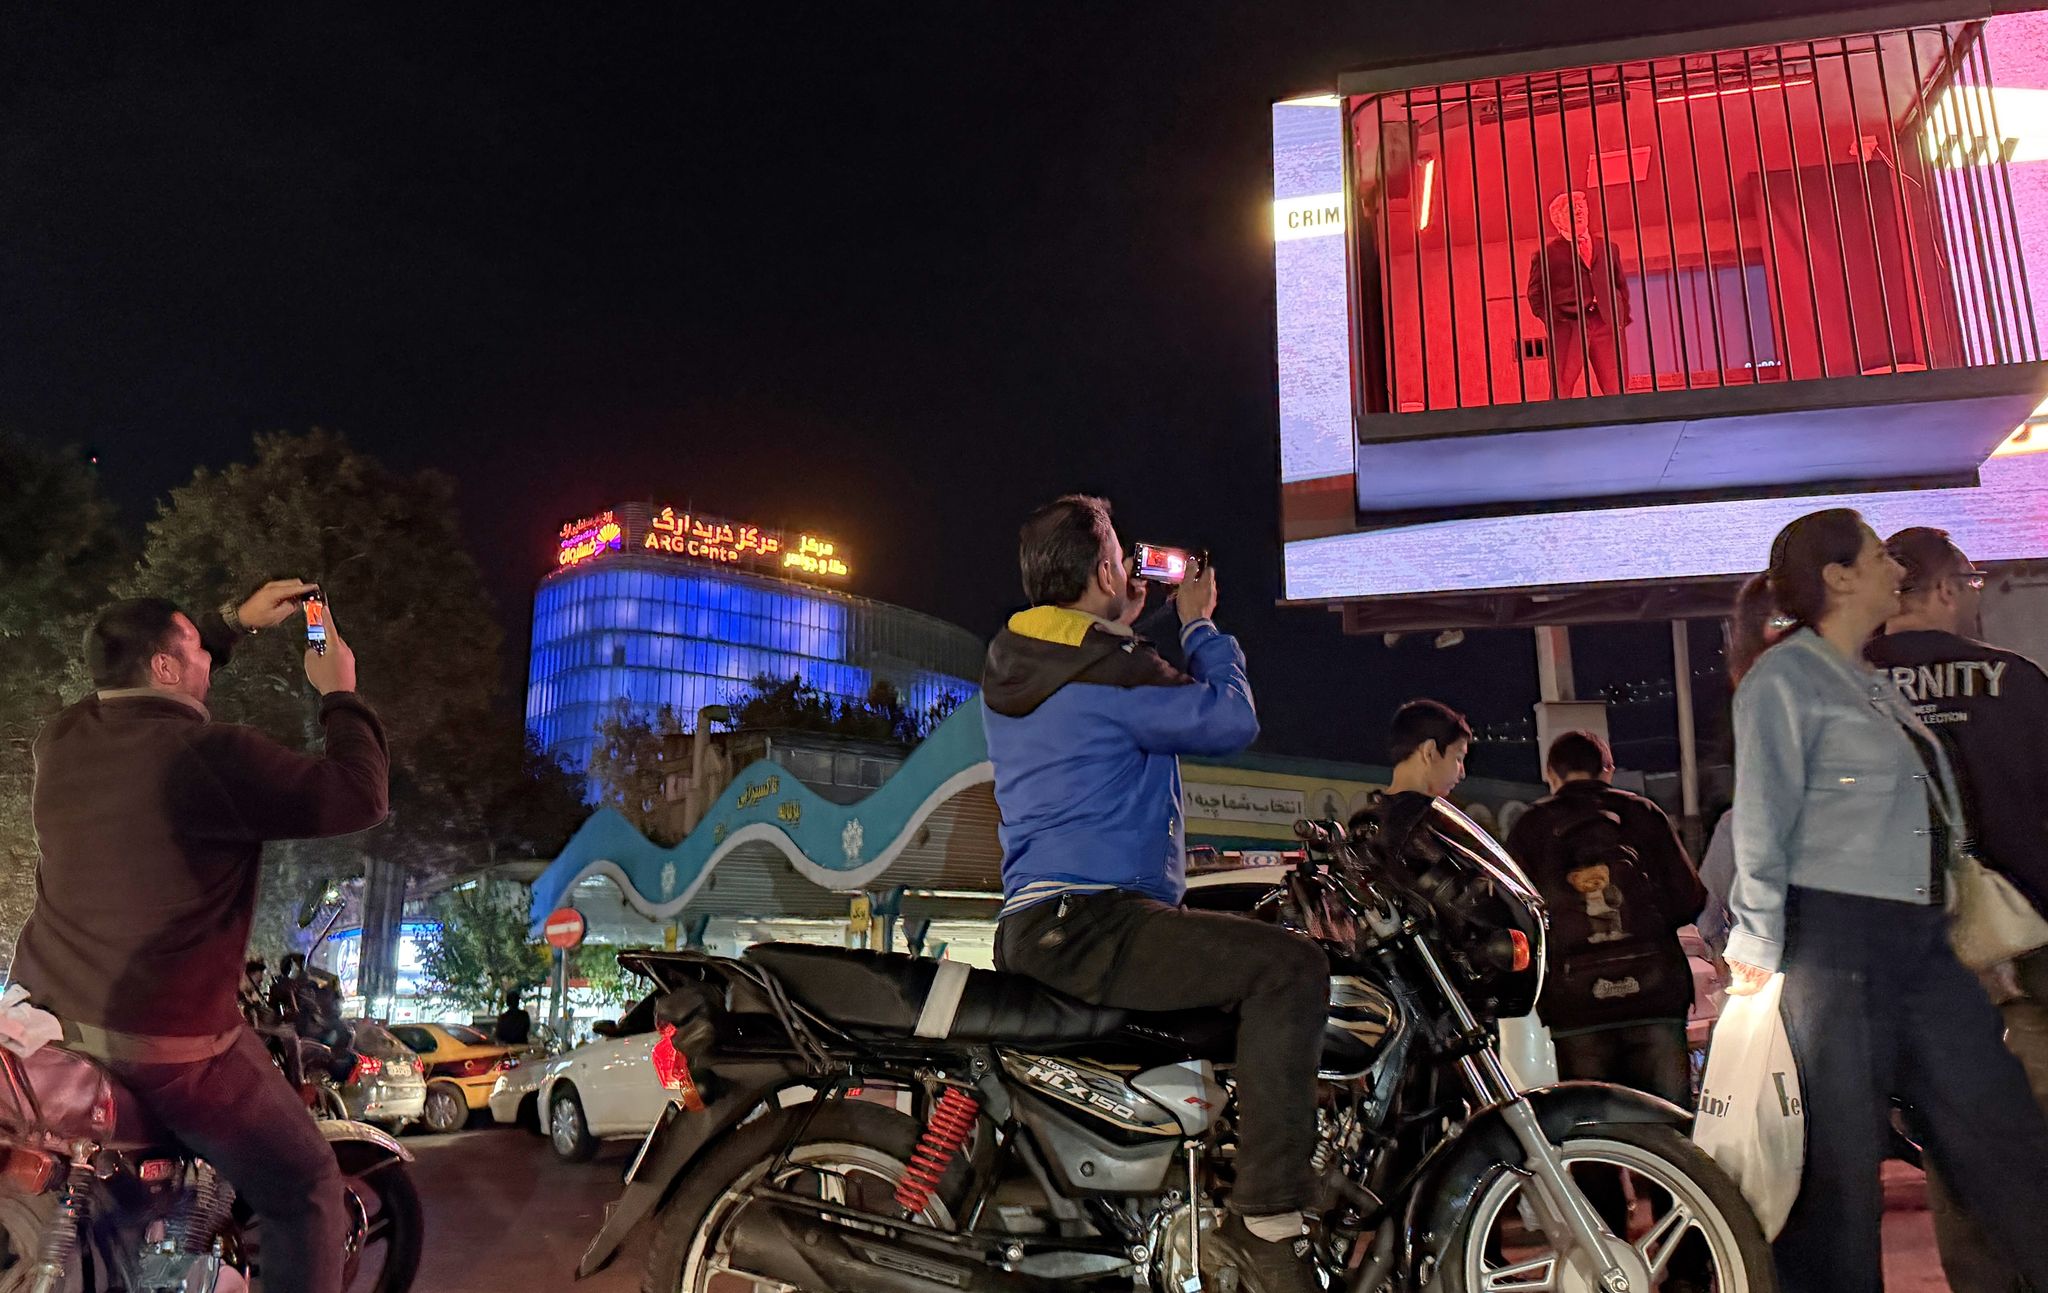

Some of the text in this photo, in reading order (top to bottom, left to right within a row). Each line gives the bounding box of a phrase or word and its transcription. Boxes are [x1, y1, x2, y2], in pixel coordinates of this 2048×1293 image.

[1288, 206, 1340, 229] CRIM
[652, 507, 778, 554] مرکز خرید ارگ
[645, 532, 685, 552] ARG
[799, 535, 834, 557] مرکز
[1877, 661, 2006, 700] RNITY
[1222, 793, 1251, 811] شما
[1253, 799, 1302, 817] انتخاب
[1027, 1065, 1135, 1119] HLX 150
